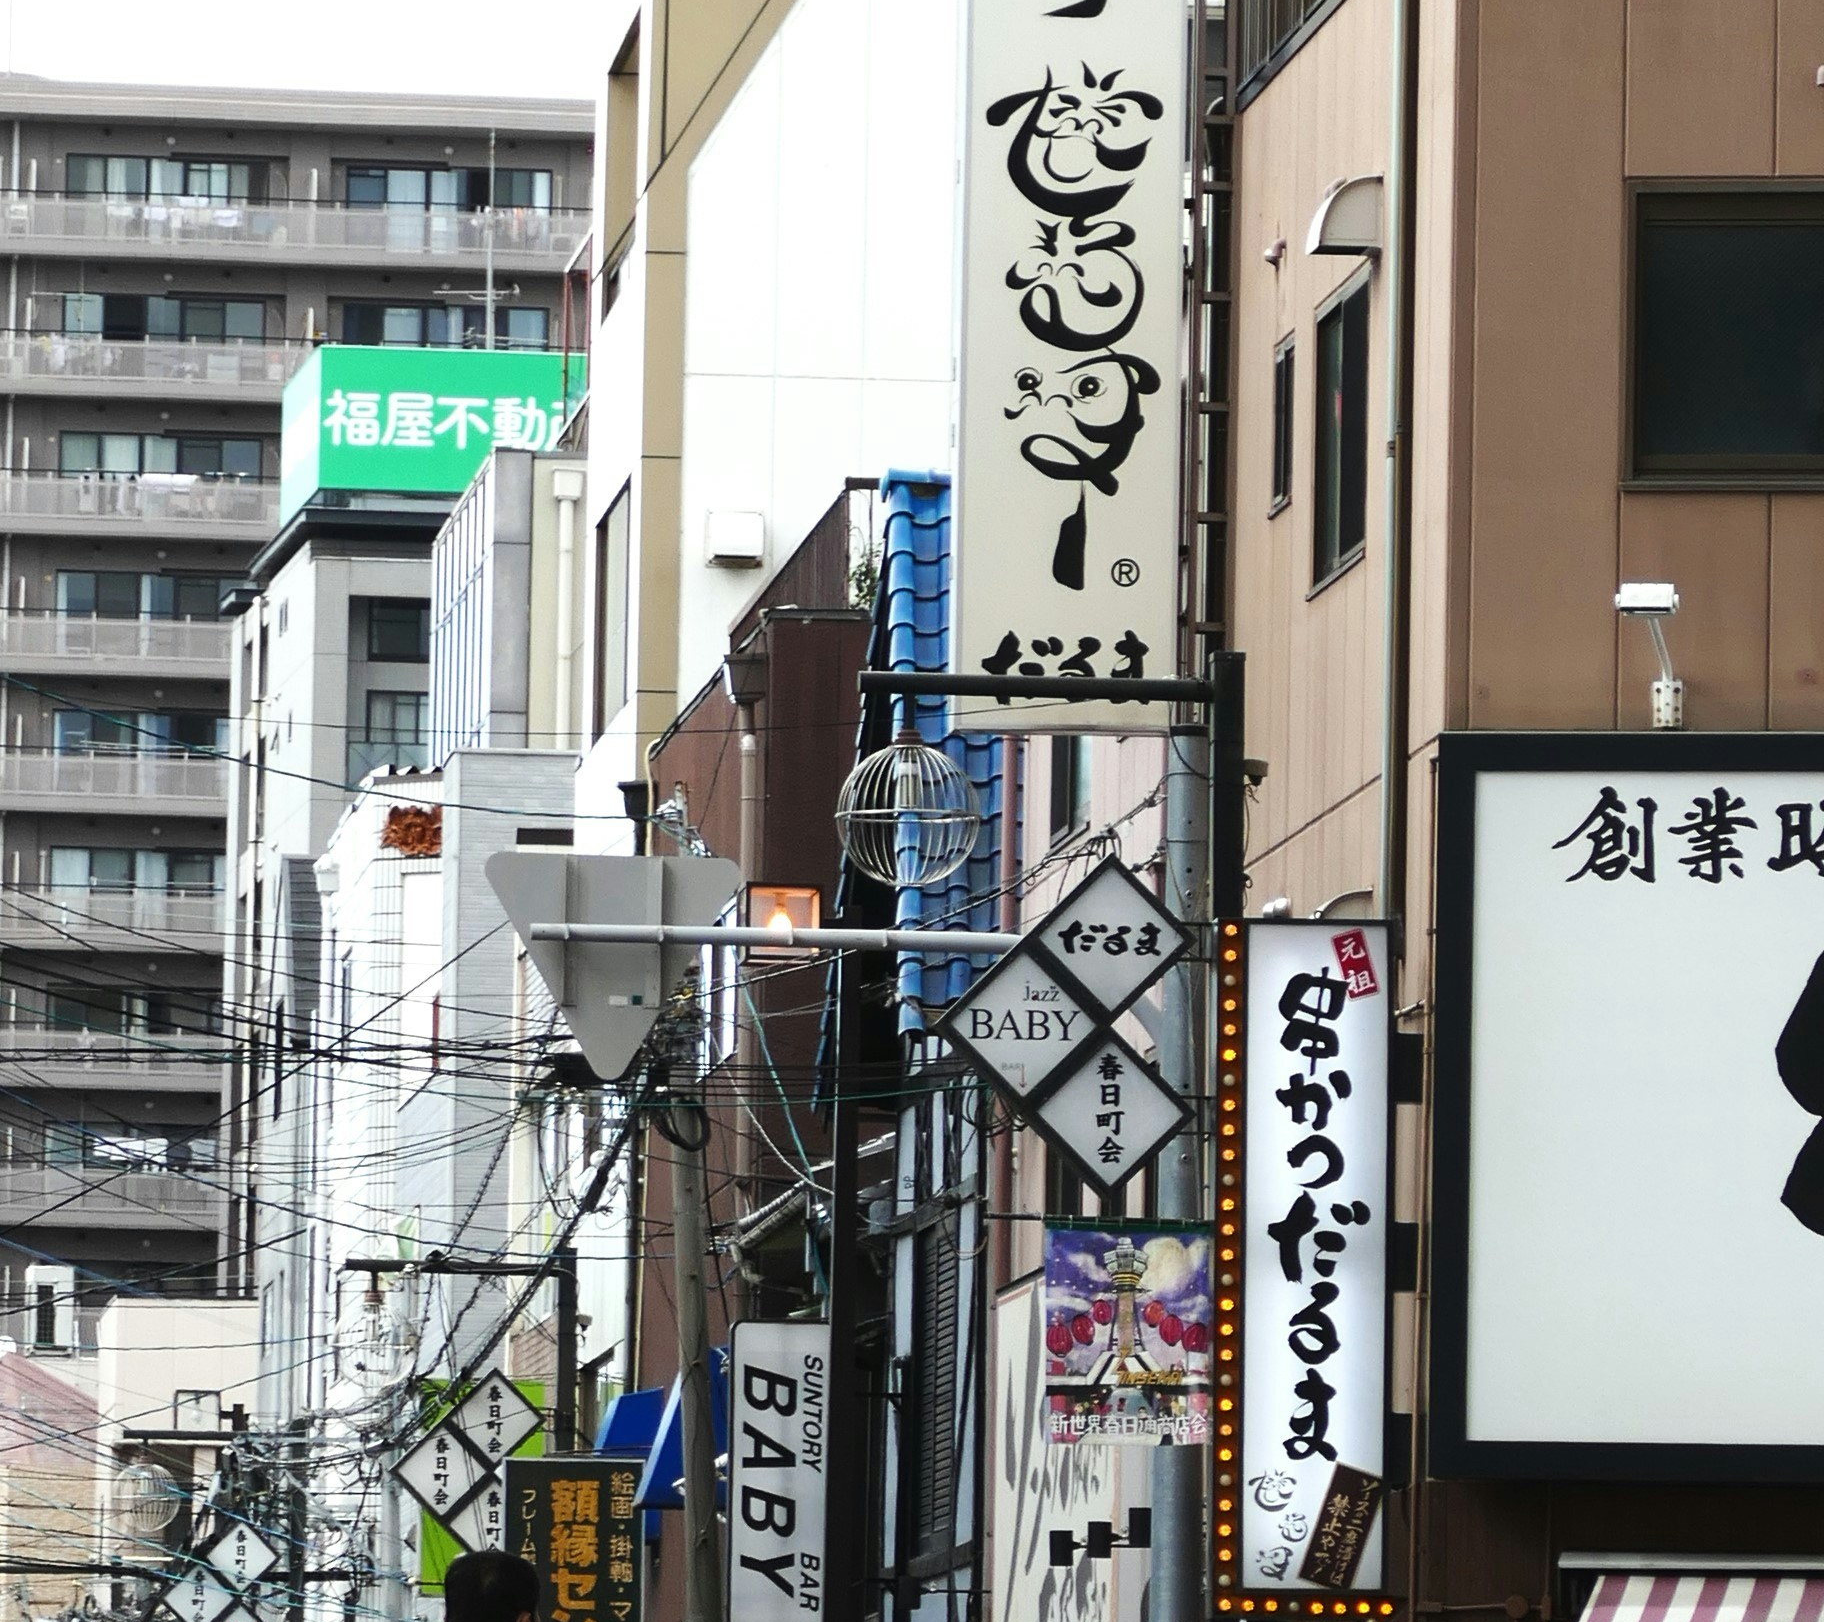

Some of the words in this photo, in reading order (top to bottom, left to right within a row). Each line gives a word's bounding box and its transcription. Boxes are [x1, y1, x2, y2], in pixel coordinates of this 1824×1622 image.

[1058, 920, 1162, 956] だるま
[1341, 936, 1376, 995] 元祖
[969, 1008, 1080, 1041] BABY
[1096, 1054, 1125, 1165] 春日町会
[1267, 966, 1372, 1462] 串かつだるま
[487, 1384, 504, 1453] 春日町会
[801, 1354, 824, 1473] SUNTORY
[434, 1438, 450, 1506] 春日町会
[739, 1364, 798, 1599] BABY
[798, 1551, 821, 1612] BAR
